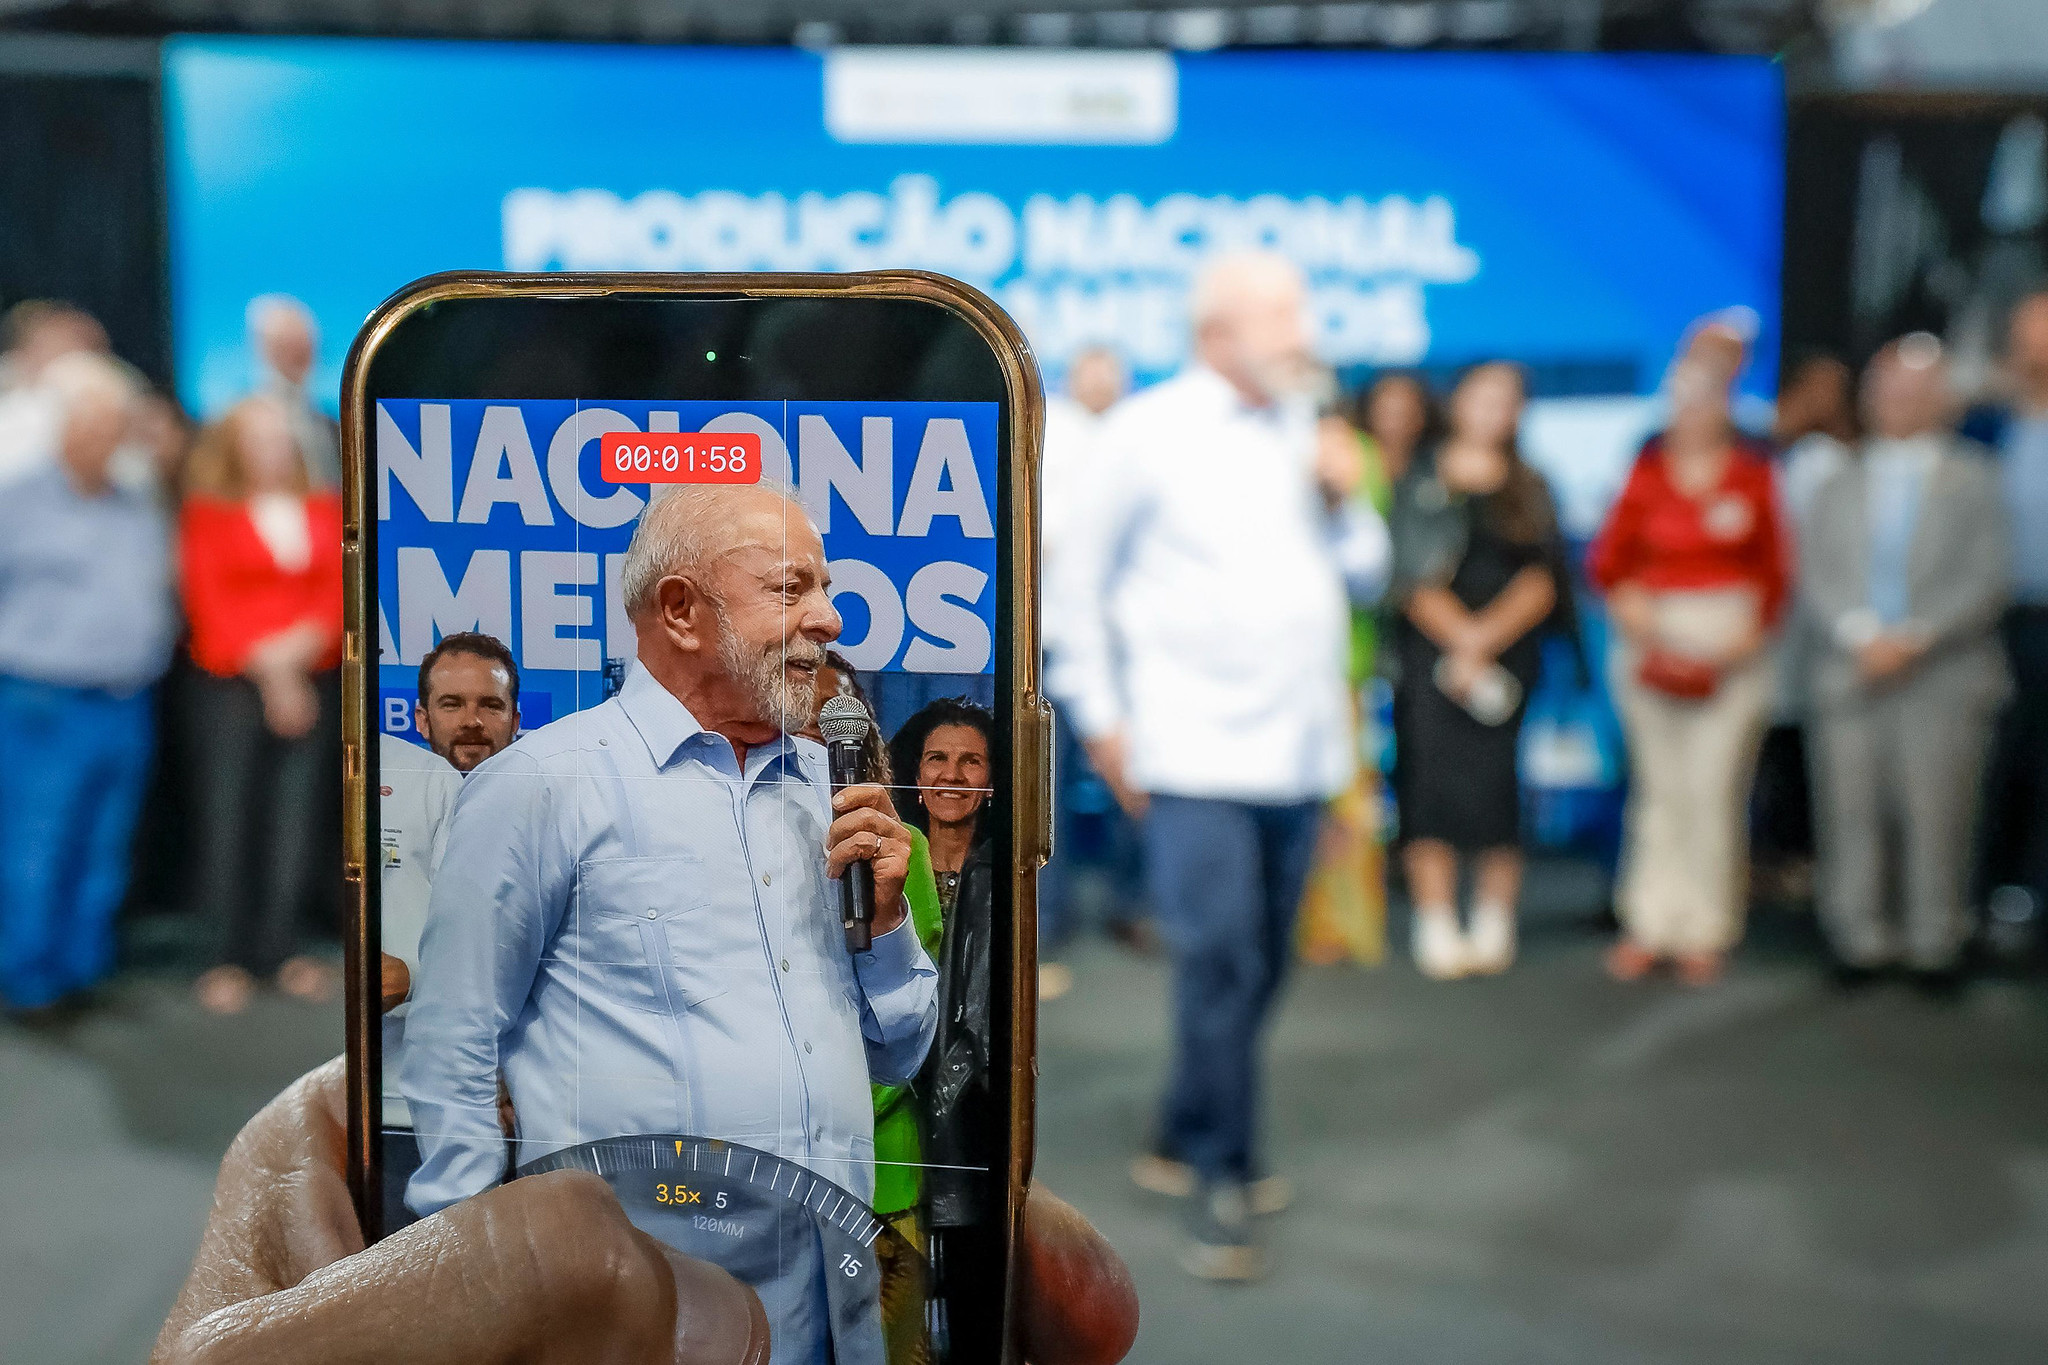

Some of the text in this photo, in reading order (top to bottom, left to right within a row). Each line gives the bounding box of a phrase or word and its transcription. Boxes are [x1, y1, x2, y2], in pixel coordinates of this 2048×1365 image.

[614, 444, 748, 473] 00:01:58
[655, 1183, 728, 1209] 3,5x 5
[693, 1214, 745, 1239] 120MM
[838, 1253, 863, 1278] 15
